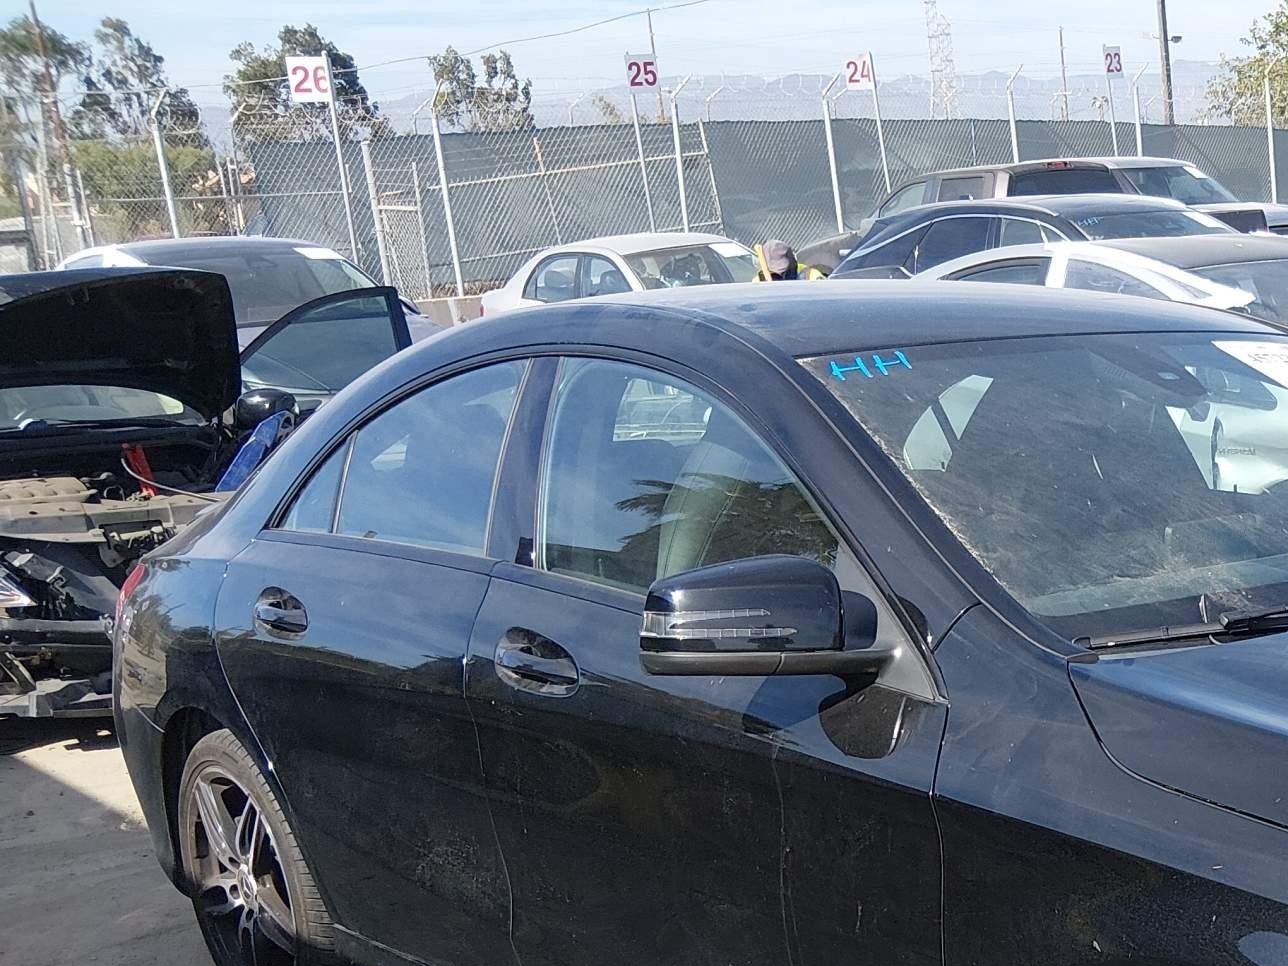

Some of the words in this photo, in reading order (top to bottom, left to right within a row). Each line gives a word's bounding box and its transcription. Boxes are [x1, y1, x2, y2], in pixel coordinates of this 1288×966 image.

[628, 61, 657, 87] 25
[846, 60, 872, 83] 24
[1105, 52, 1122, 73] 23
[291, 65, 328, 93] 26
[829, 350, 913, 381] HH
